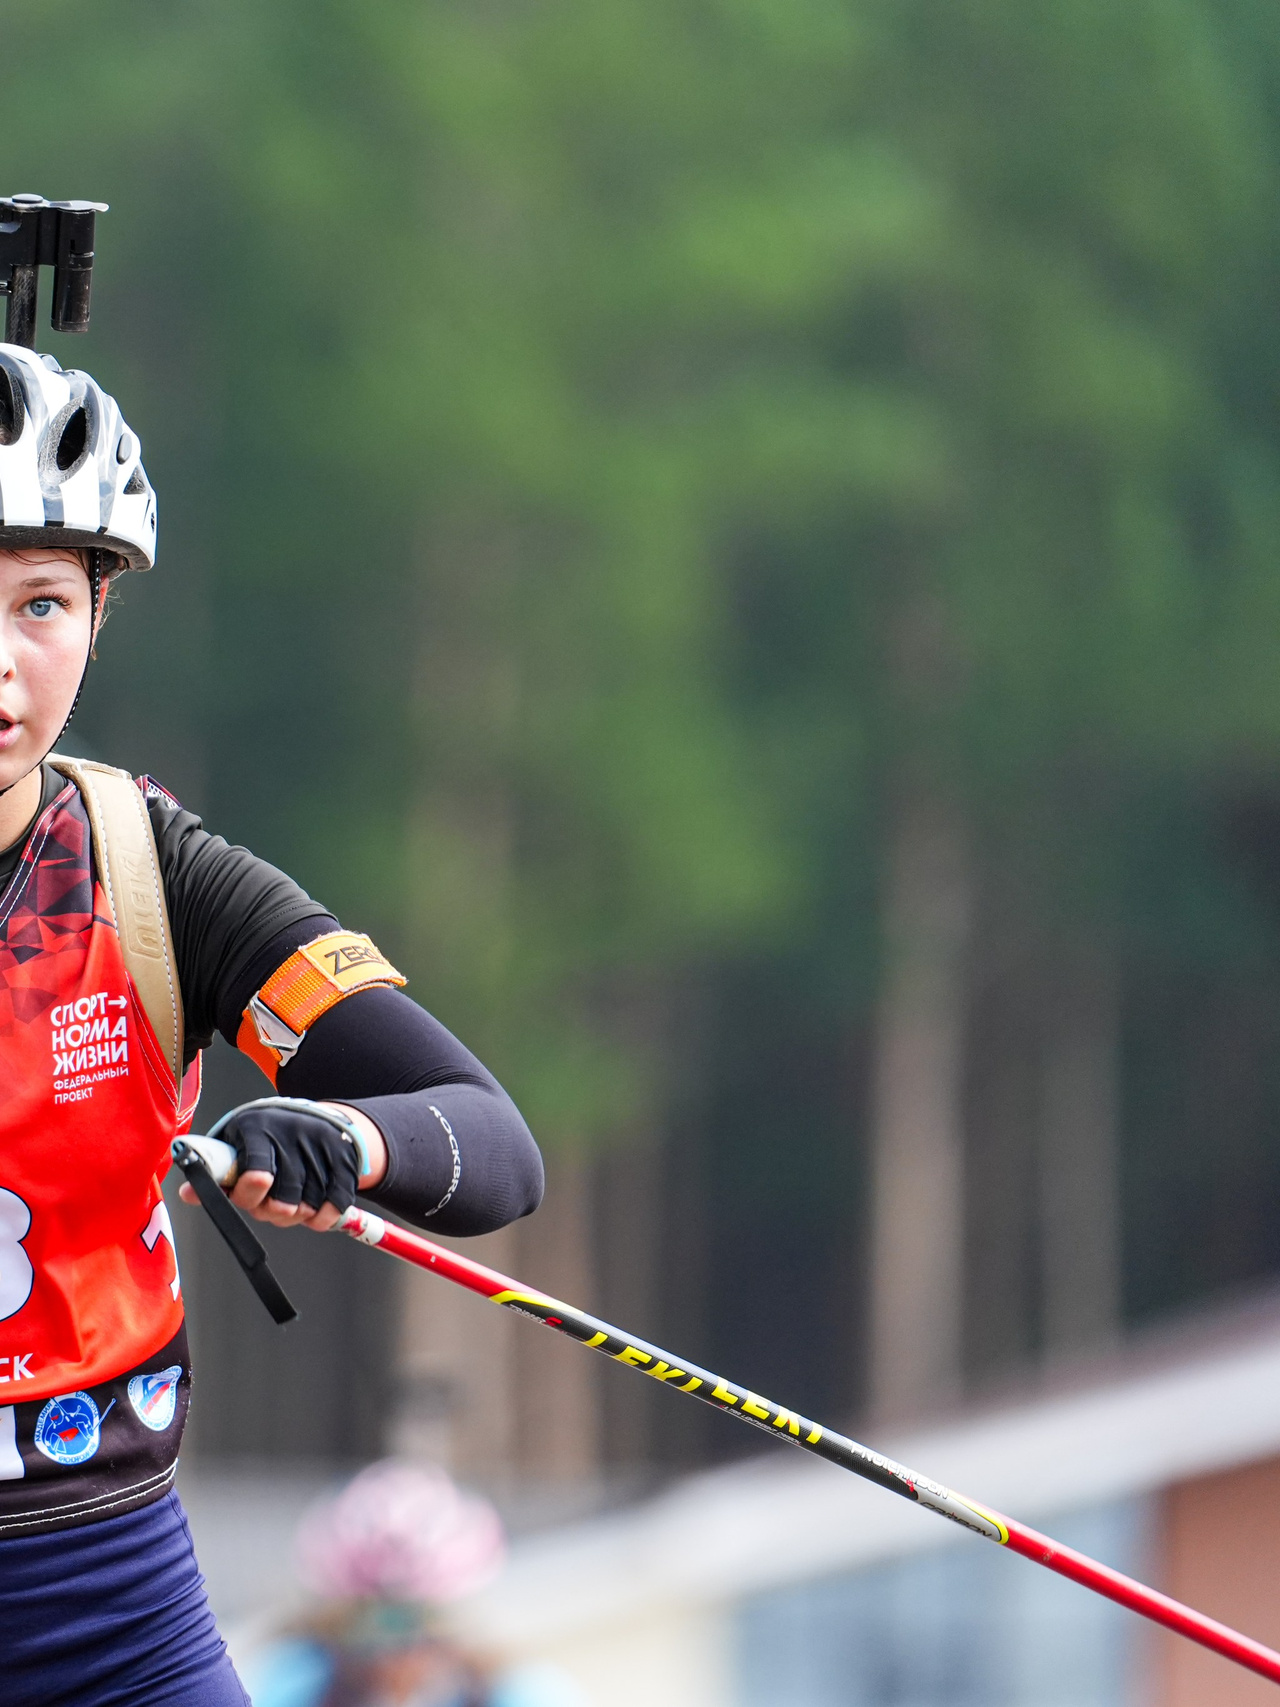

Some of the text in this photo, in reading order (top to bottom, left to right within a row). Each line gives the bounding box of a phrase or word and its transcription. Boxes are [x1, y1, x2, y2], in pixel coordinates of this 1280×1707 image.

[50, 992, 109, 1027] СПОРТ
[52, 1016, 127, 1051] НОРМА
[52, 1041, 128, 1076] ЖИЗНИ
[53, 1064, 129, 1091] ФЕДЕРАЛЬНЫЙ
[54, 1087, 93, 1104] ПРОЕКТ
[426, 1104, 461, 1217] ROCKBROS
[710, 1376, 823, 1445] LEKI
